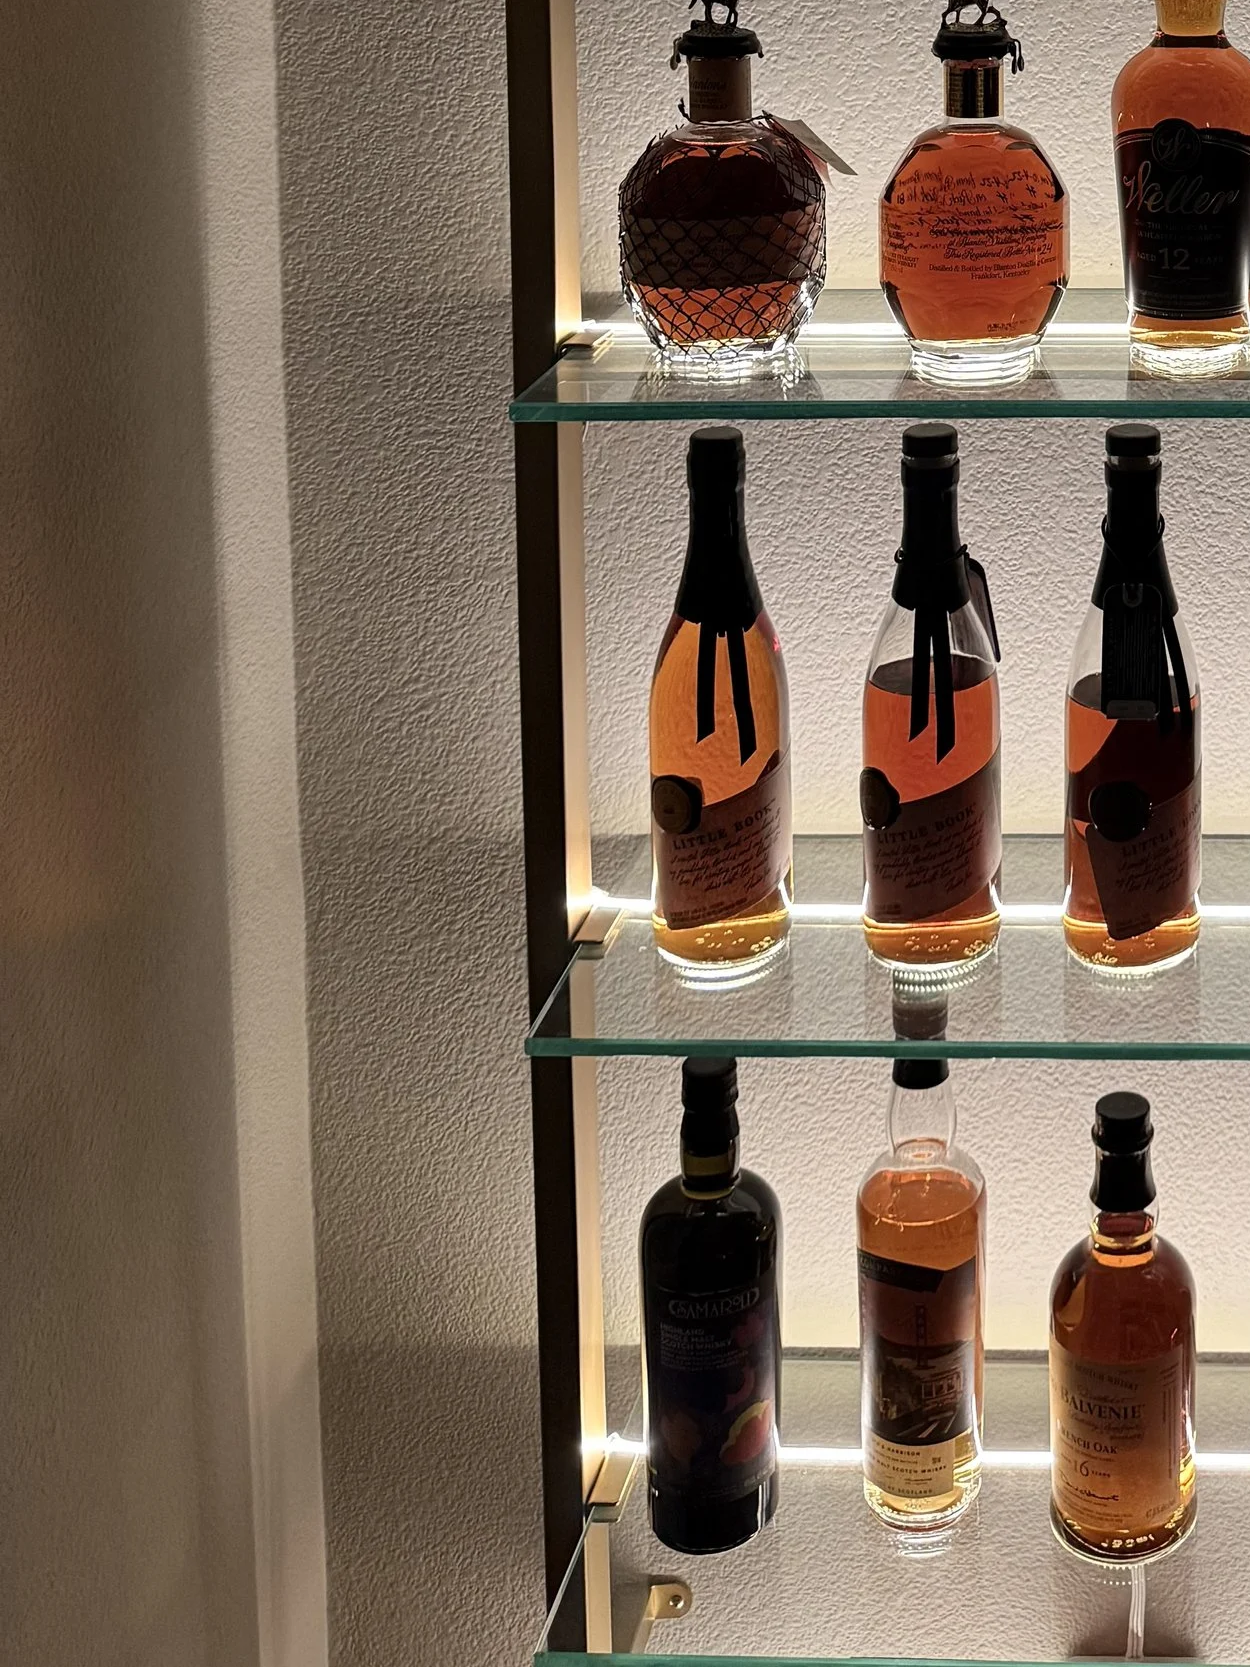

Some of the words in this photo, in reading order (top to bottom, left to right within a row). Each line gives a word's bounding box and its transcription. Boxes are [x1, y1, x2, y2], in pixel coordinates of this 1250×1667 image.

[1122, 160, 1240, 215] Weller
[944, 247, 962, 260] This
[962, 248, 1001, 262] Registered
[1158, 248, 1191, 271] 12
[929, 263, 954, 273] Distilled
[954, 264, 960, 273] &
[962, 262, 984, 272] Bottled
[984, 264, 993, 272] by
[994, 260, 1017, 271] Blanton
[971, 272, 1002, 280] Frankfort,
[672, 828, 728, 851] LITTLE
[734, 798, 776, 832] BOOK
[878, 826, 929, 844] LITTLE
[934, 804, 975, 832] BOOK
[1122, 826, 1174, 857] LITTLE
[690, 1334, 716, 1343] MALT
[1061, 1386, 1142, 1421] BALVENIE
[888, 1447, 921, 1456] HARRISON
[1094, 1441, 1118, 1454] OAK
[892, 1466, 919, 1474] SCOTCH
[921, 1465, 947, 1474] WHISKY
[1074, 1460, 1090, 1477] 16
[898, 1488, 933, 1496] SCOTLAND
